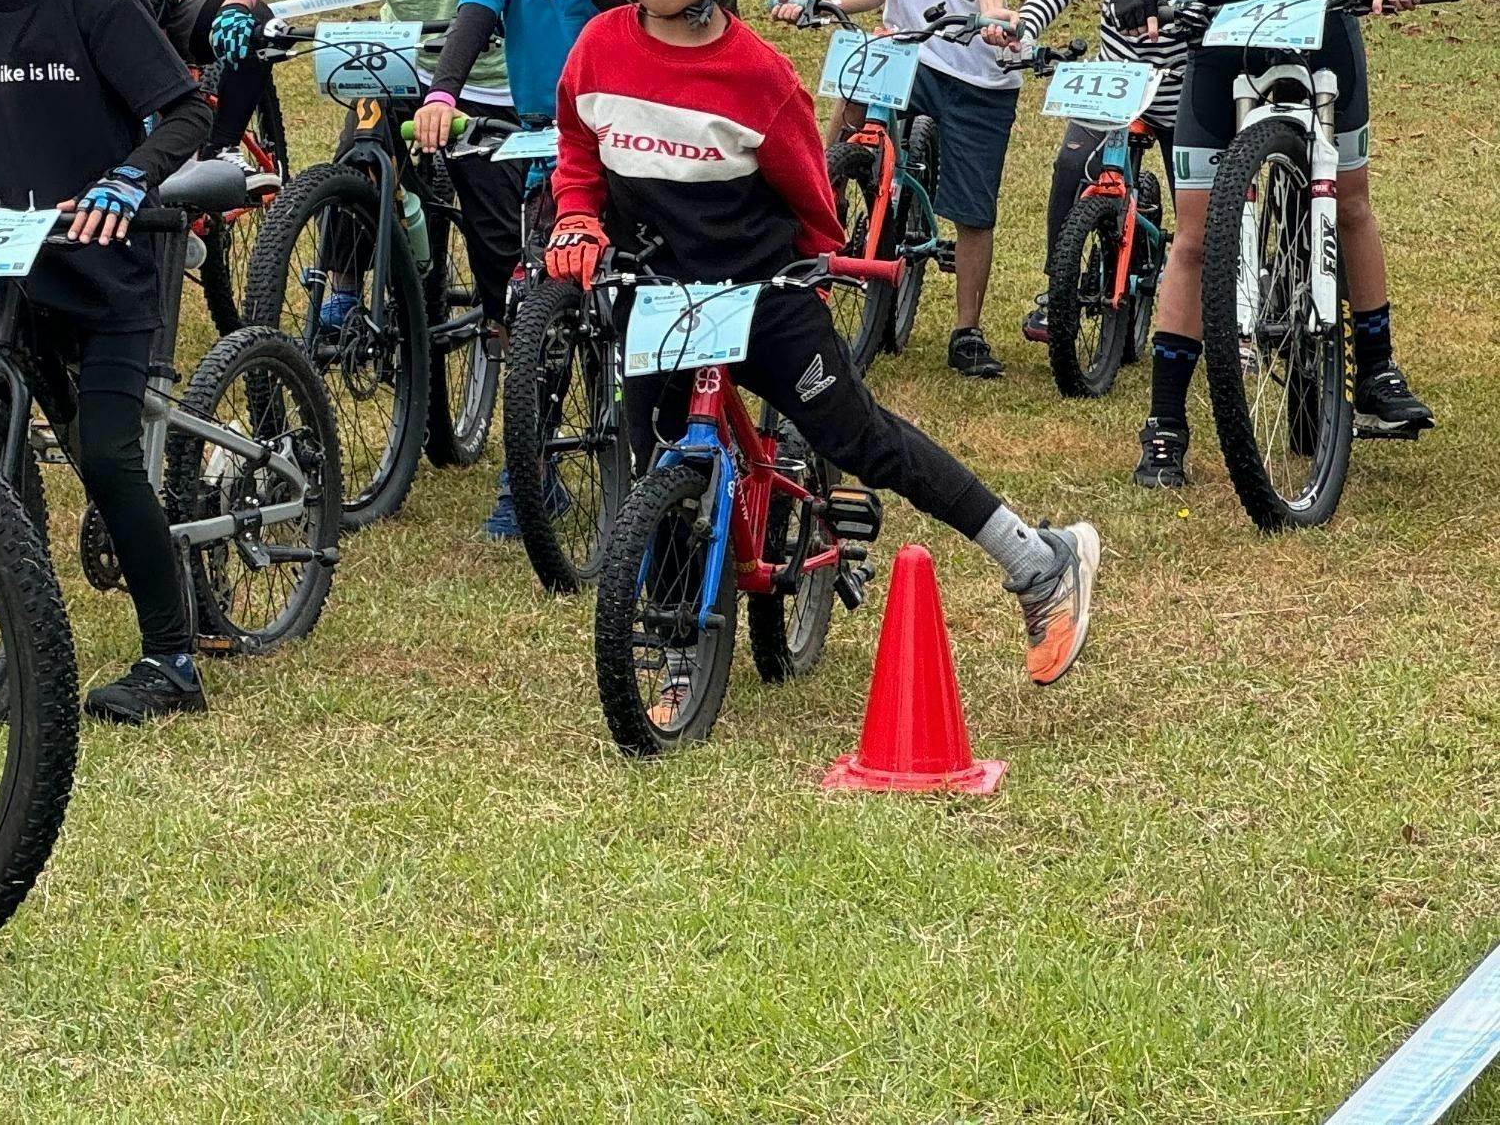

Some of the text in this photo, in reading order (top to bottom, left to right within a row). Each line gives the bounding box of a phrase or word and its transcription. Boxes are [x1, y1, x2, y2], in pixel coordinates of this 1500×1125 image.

[343, 42, 388, 72] 28
[847, 50, 890, 78] 27
[29, 63, 44, 81] is
[48, 63, 81, 82] life.
[1063, 74, 1130, 100] 413
[611, 132, 726, 162] HONDA
[548, 232, 584, 249] FOX
[1340, 298, 1354, 403] MAXXIS
